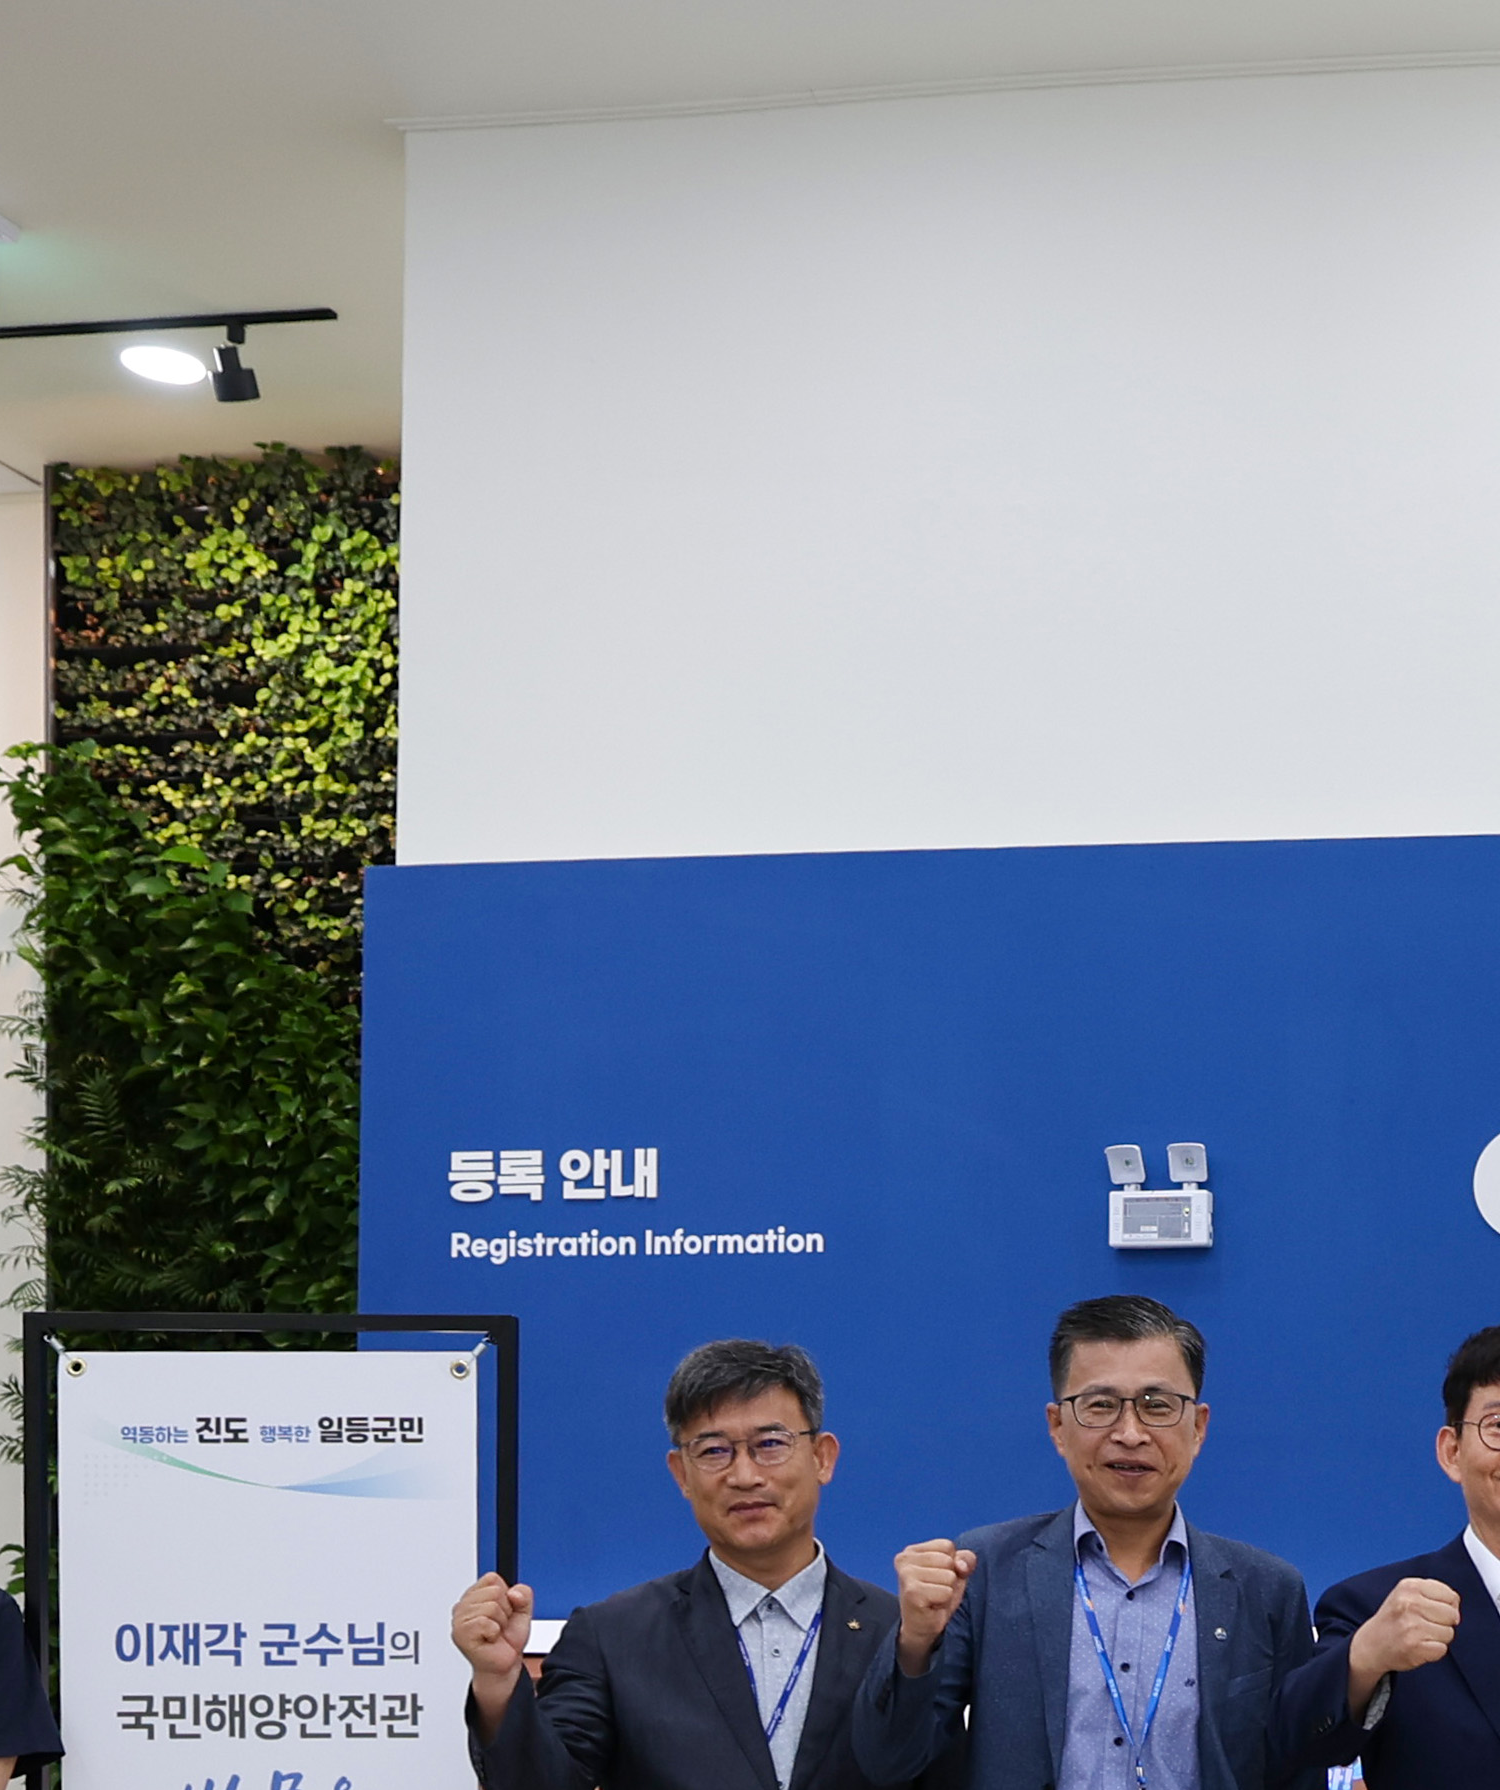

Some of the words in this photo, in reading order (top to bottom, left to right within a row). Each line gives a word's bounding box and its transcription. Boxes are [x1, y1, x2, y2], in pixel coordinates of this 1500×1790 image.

[448, 1150, 546, 1203] 등록
[558, 1147, 659, 1200] 안내
[450, 1229, 638, 1265] Registration
[644, 1226, 825, 1258] Information
[120, 1426, 189, 1444] 역동하는
[195, 1416, 250, 1444] 진도
[259, 1426, 312, 1444] 행복한
[317, 1416, 425, 1444] 일등군민
[114, 1622, 248, 1667] 이재각
[258, 1621, 421, 1667] 군수님의
[116, 1692, 425, 1741] 국민해양안전관
